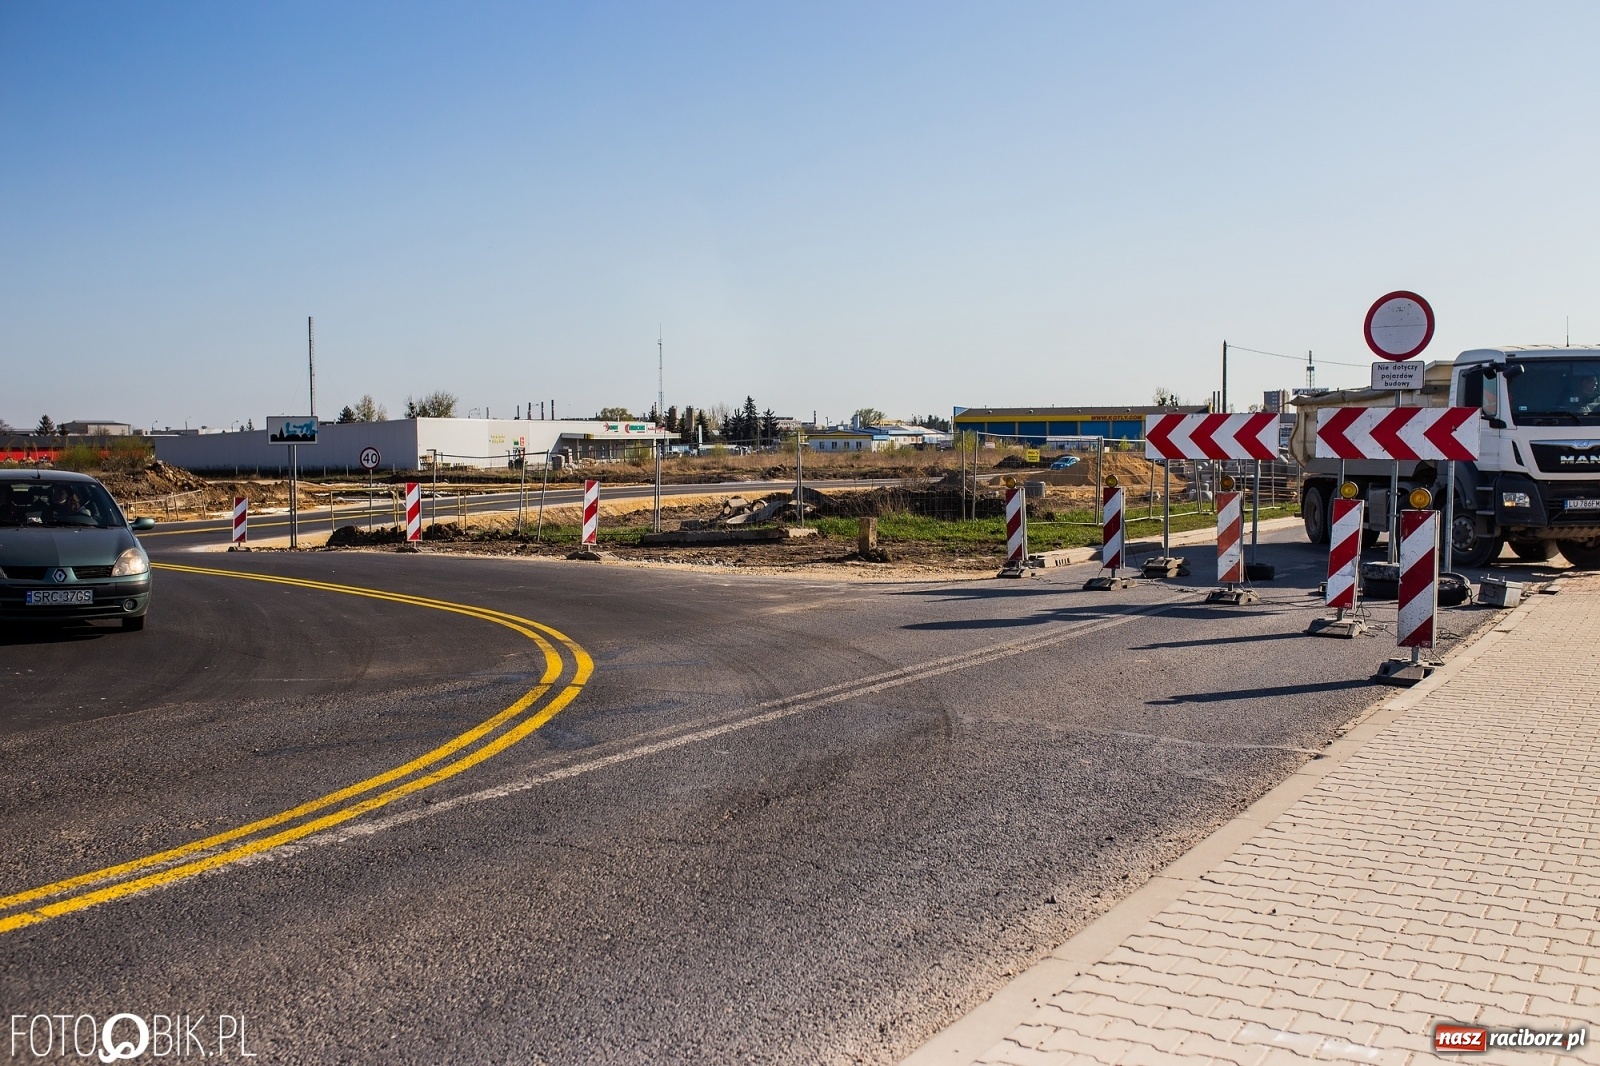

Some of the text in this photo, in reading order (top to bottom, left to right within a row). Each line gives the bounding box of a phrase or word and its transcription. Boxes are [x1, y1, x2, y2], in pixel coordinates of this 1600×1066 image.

[362, 452, 378, 464] 40
[1560, 455, 1600, 464] MAN
[1569, 500, 1578, 508] LU
[33, 591, 59, 602] SRC
